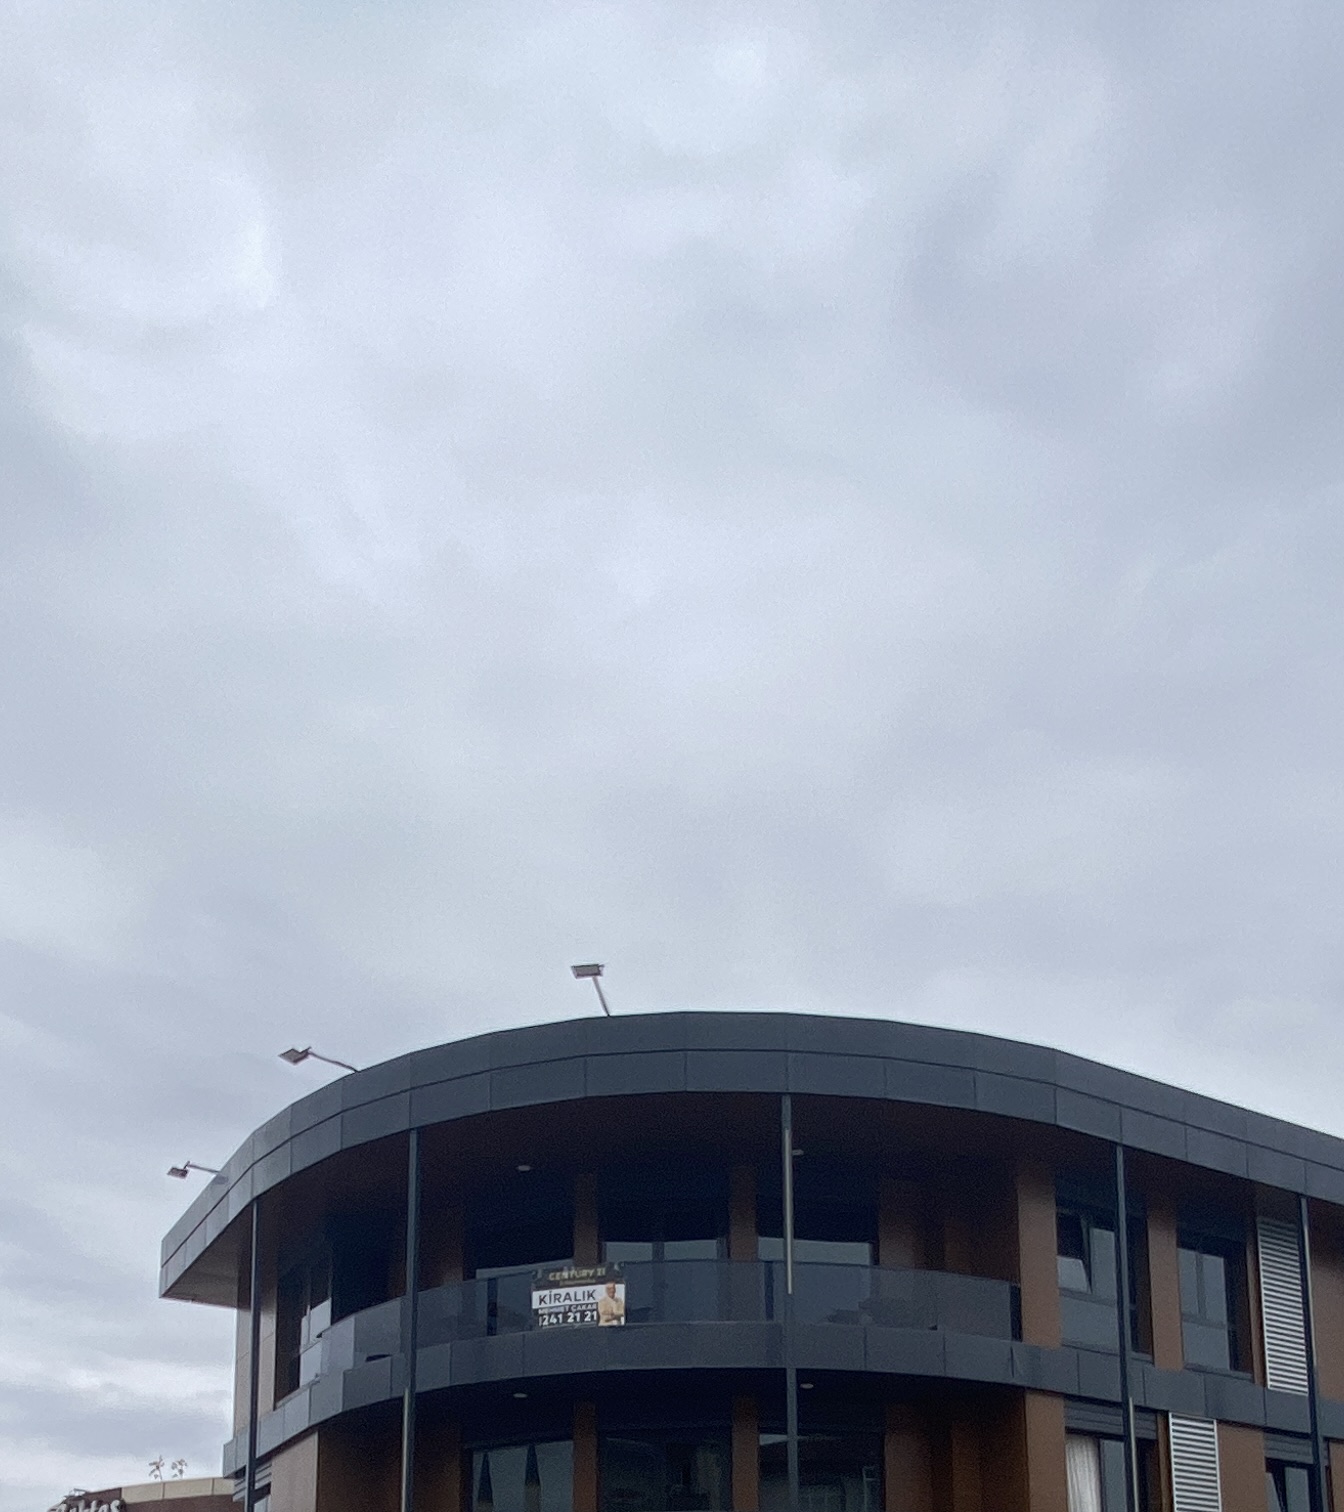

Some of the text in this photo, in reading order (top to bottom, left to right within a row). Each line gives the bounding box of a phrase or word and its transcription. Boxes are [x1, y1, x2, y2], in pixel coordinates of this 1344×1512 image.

[538, 1289, 597, 1306] KİRALIK
[567, 1313, 582, 1323] 21
[584, 1311, 597, 1322] 21
